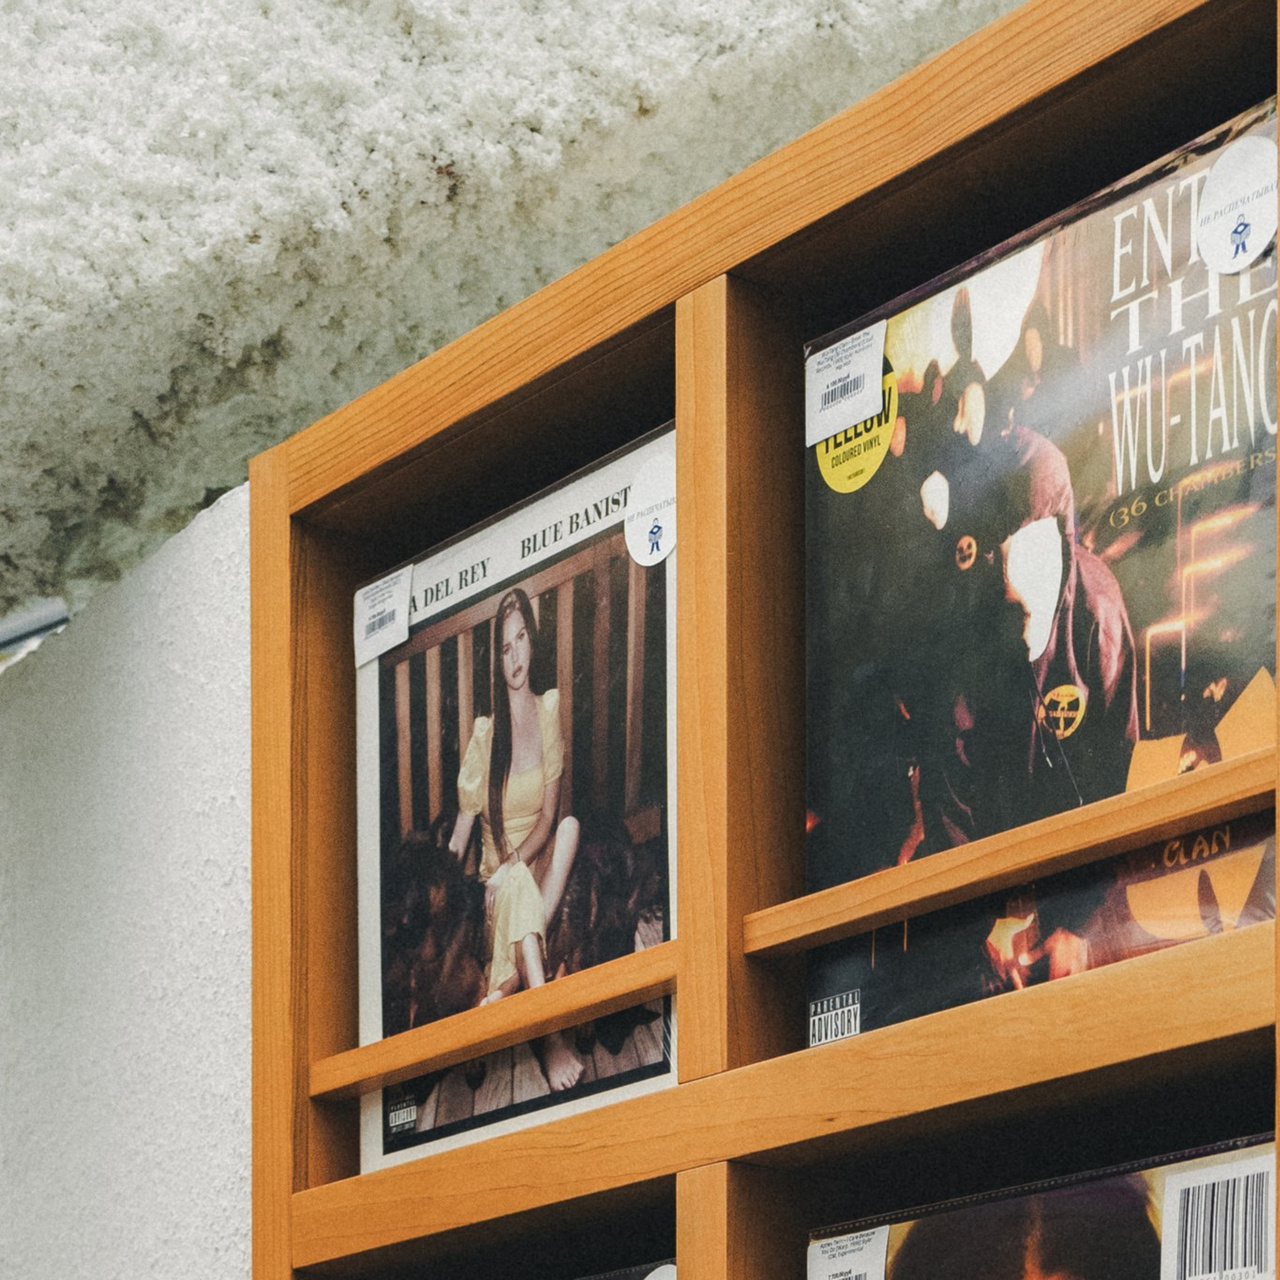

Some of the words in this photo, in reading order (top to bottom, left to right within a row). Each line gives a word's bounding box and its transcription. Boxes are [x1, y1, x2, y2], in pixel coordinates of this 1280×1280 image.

[1213, 181, 1278, 221] РАСПЕЧАТЫВА
[831, 443, 862, 469] COLOURED
[863, 435, 881, 453] VINYL
[423, 580, 454, 608] DEL
[458, 557, 491, 589] REY
[520, 524, 563, 560] BLUE
[568, 485, 632, 534] BANIST
[810, 991, 859, 1016] PARENTAL
[810, 1006, 859, 1046] ADVISORY
